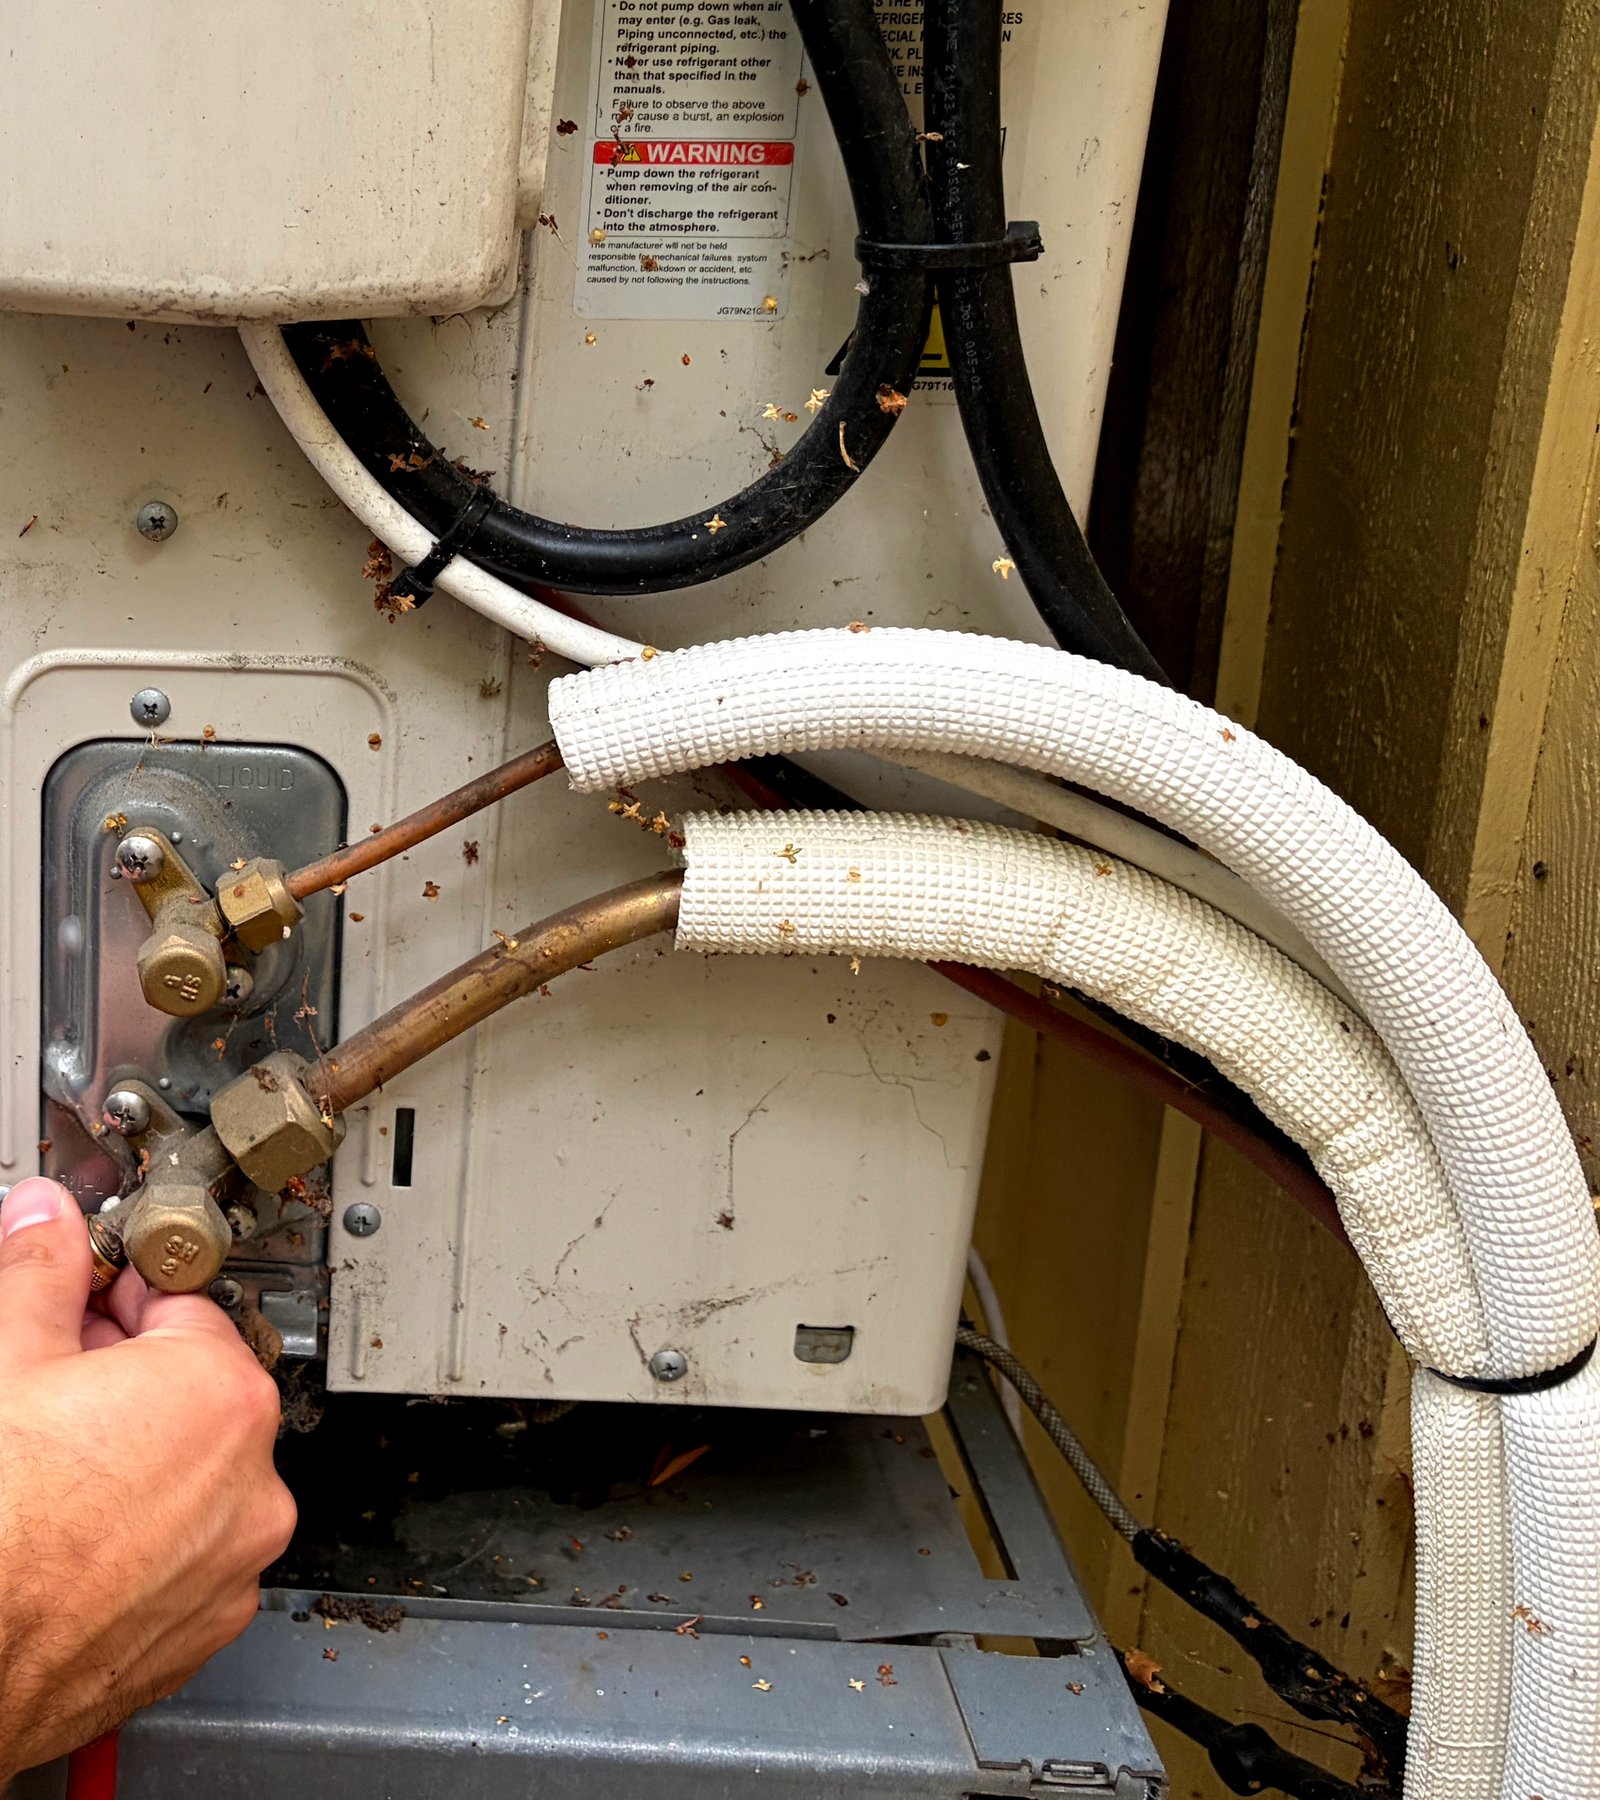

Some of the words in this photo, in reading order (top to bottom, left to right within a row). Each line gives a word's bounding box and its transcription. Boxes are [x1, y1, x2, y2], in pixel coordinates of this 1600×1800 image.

[620, 2, 636, 11] Do
[640, 2, 657, 11] not
[661, 3, 693, 13] pump
[698, 2, 729, 11] down
[734, 2, 764, 11] when
[768, 2, 782, 11] air
[619, 17, 642, 28] may
[647, 17, 676, 25] enter
[680, 15, 704, 28] (e.g.
[708, 16, 730, 25] Gas
[734, 16, 760, 27] leak,
[618, 30, 654, 41] Piping
[658, 30, 736, 40] unconnected,
[740, 30, 765, 41] etc.)
[769, 30, 787, 39] the
[617, 44, 677, 55] refrigerant
[681, 44, 719, 54] piping.
[907, 48, 923, 60] PL
[616, 58, 648, 67] Ner
[653, 58, 672, 67] use
[677, 57, 737, 68] refrigerant
[741, 58, 771, 67] other
[615, 71, 640, 81] than
[644, 71, 665, 81] that
[669, 71, 721, 82] specified
[725, 71, 735, 81] in
[739, 71, 756, 81] the
[614, 85, 665, 94] manuals.
[652, 100, 662, 109] to
[665, 100, 708, 109] observe
[712, 100, 729, 109] the
[732, 100, 765, 109] above
[611, 112, 634, 123] my
[637, 112, 669, 121] cause
[673, 112, 679, 121] a
[683, 112, 712, 122] burst,
[716, 112, 729, 121] an
[733, 112, 784, 124] explosion
[625, 124, 631, 133] a
[647, 143, 765, 163] WARNING
[607, 169, 640, 180] Pump
[644, 169, 674, 178] down
[678, 169, 696, 178] the
[700, 169, 759, 181] refrigerant
[606, 183, 636, 192] when
[640, 182, 693, 194] removing
[697, 182, 709, 192] of
[712, 183, 729, 192] the
[733, 183, 747, 192] air
[752, 183, 776, 192] con-
[605, 196, 651, 205] ditioner.
[604, 209, 634, 219] Don't
[637, 209, 693, 221] discharge
[697, 209, 714, 219] the
[718, 209, 777, 221] refrigerant
[603, 222, 624, 231] into
[628, 222, 645, 231] the
[649, 222, 719, 234] atmosphere.
[608, 242, 662, 250] manufacturer
[666, 242, 678, 250] will
[681, 242, 694, 250] not
[697, 242, 707, 250] be
[709, 242, 727, 250] held
[588, 253, 636, 263] responsible
[651, 253, 699, 262] mechanical
[737, 254, 767, 264] system
[587, 265, 637, 273] malfunction,
[640, 265, 685, 273] bkdown
[688, 265, 696, 273] or
[700, 265, 735, 275] accident,
[587, 275, 616, 284] caused
[619, 275, 629, 286] by
[632, 275, 644, 284] not
[647, 275, 684, 287] following
[686, 275, 698, 284] the
[701, 275, 751, 285] instructions.
[912, 381, 955, 391] G79T16
[217, 766, 295, 791] LIQUID
